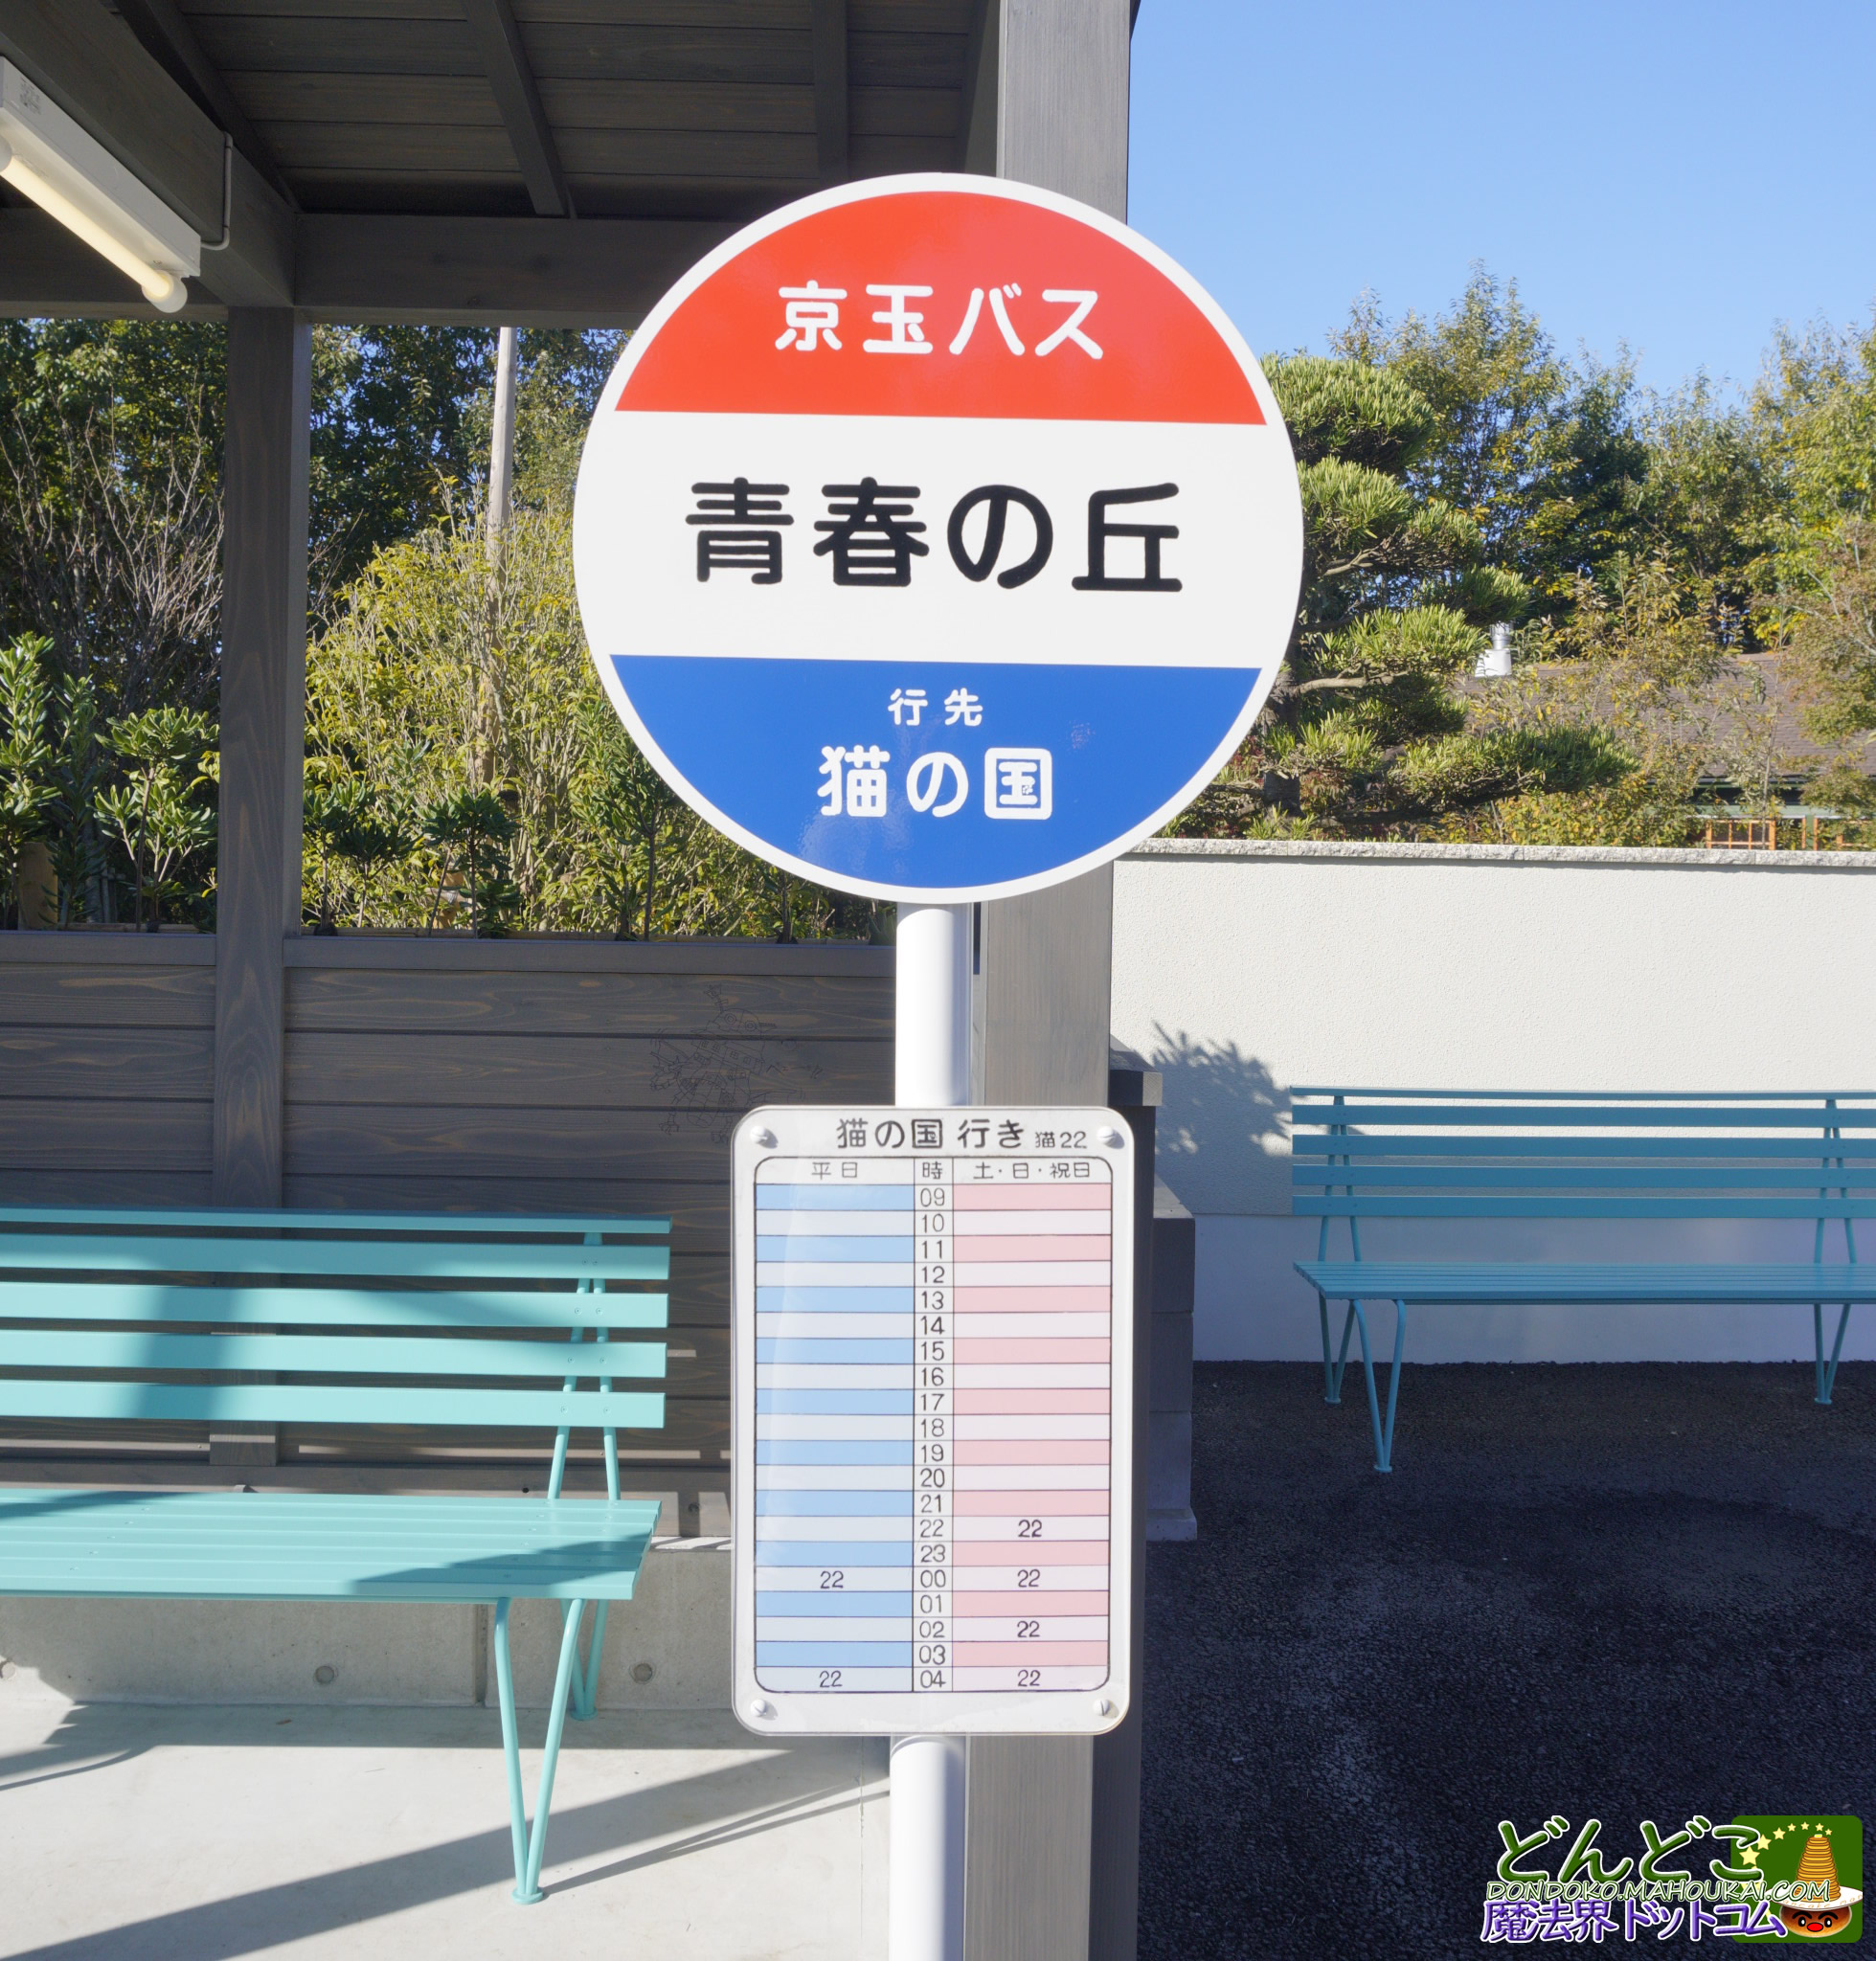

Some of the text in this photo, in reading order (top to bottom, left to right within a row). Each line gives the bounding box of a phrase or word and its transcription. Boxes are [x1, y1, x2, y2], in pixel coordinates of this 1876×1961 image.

[775, 280, 1103, 360] 京玉バス
[685, 476, 1183, 592] 青春の丘
[888, 687, 983, 727] 行先
[817, 745, 1052, 820] 猫の国
[836, 1117, 1088, 1149] 猫の国 行き 猫22
[811, 1161, 859, 1180] 平日
[922, 1161, 943, 1180] 時
[920, 1187, 945, 1208] 09
[921, 1213, 945, 1233] 10
[921, 1239, 944, 1260] 11
[921, 1265, 945, 1284] 12
[921, 1291, 944, 1310] 13
[920, 1316, 945, 1336] 14
[920, 1341, 945, 1362] 15
[921, 1366, 945, 1387] 16
[920, 1392, 945, 1412] 17
[920, 1418, 945, 1438] 18
[920, 1443, 944, 1463] 19
[919, 1468, 945, 1488] 20
[920, 1494, 942, 1514] 21
[919, 1519, 1043, 1539] 22 22
[919, 1544, 946, 1564] 23
[820, 1568, 1042, 1589] 22 00 22
[919, 1594, 942, 1614] 01
[919, 1619, 1041, 1639] 02 22
[919, 1644, 946, 1665] 03
[819, 1670, 1042, 1689] 22 04 22
